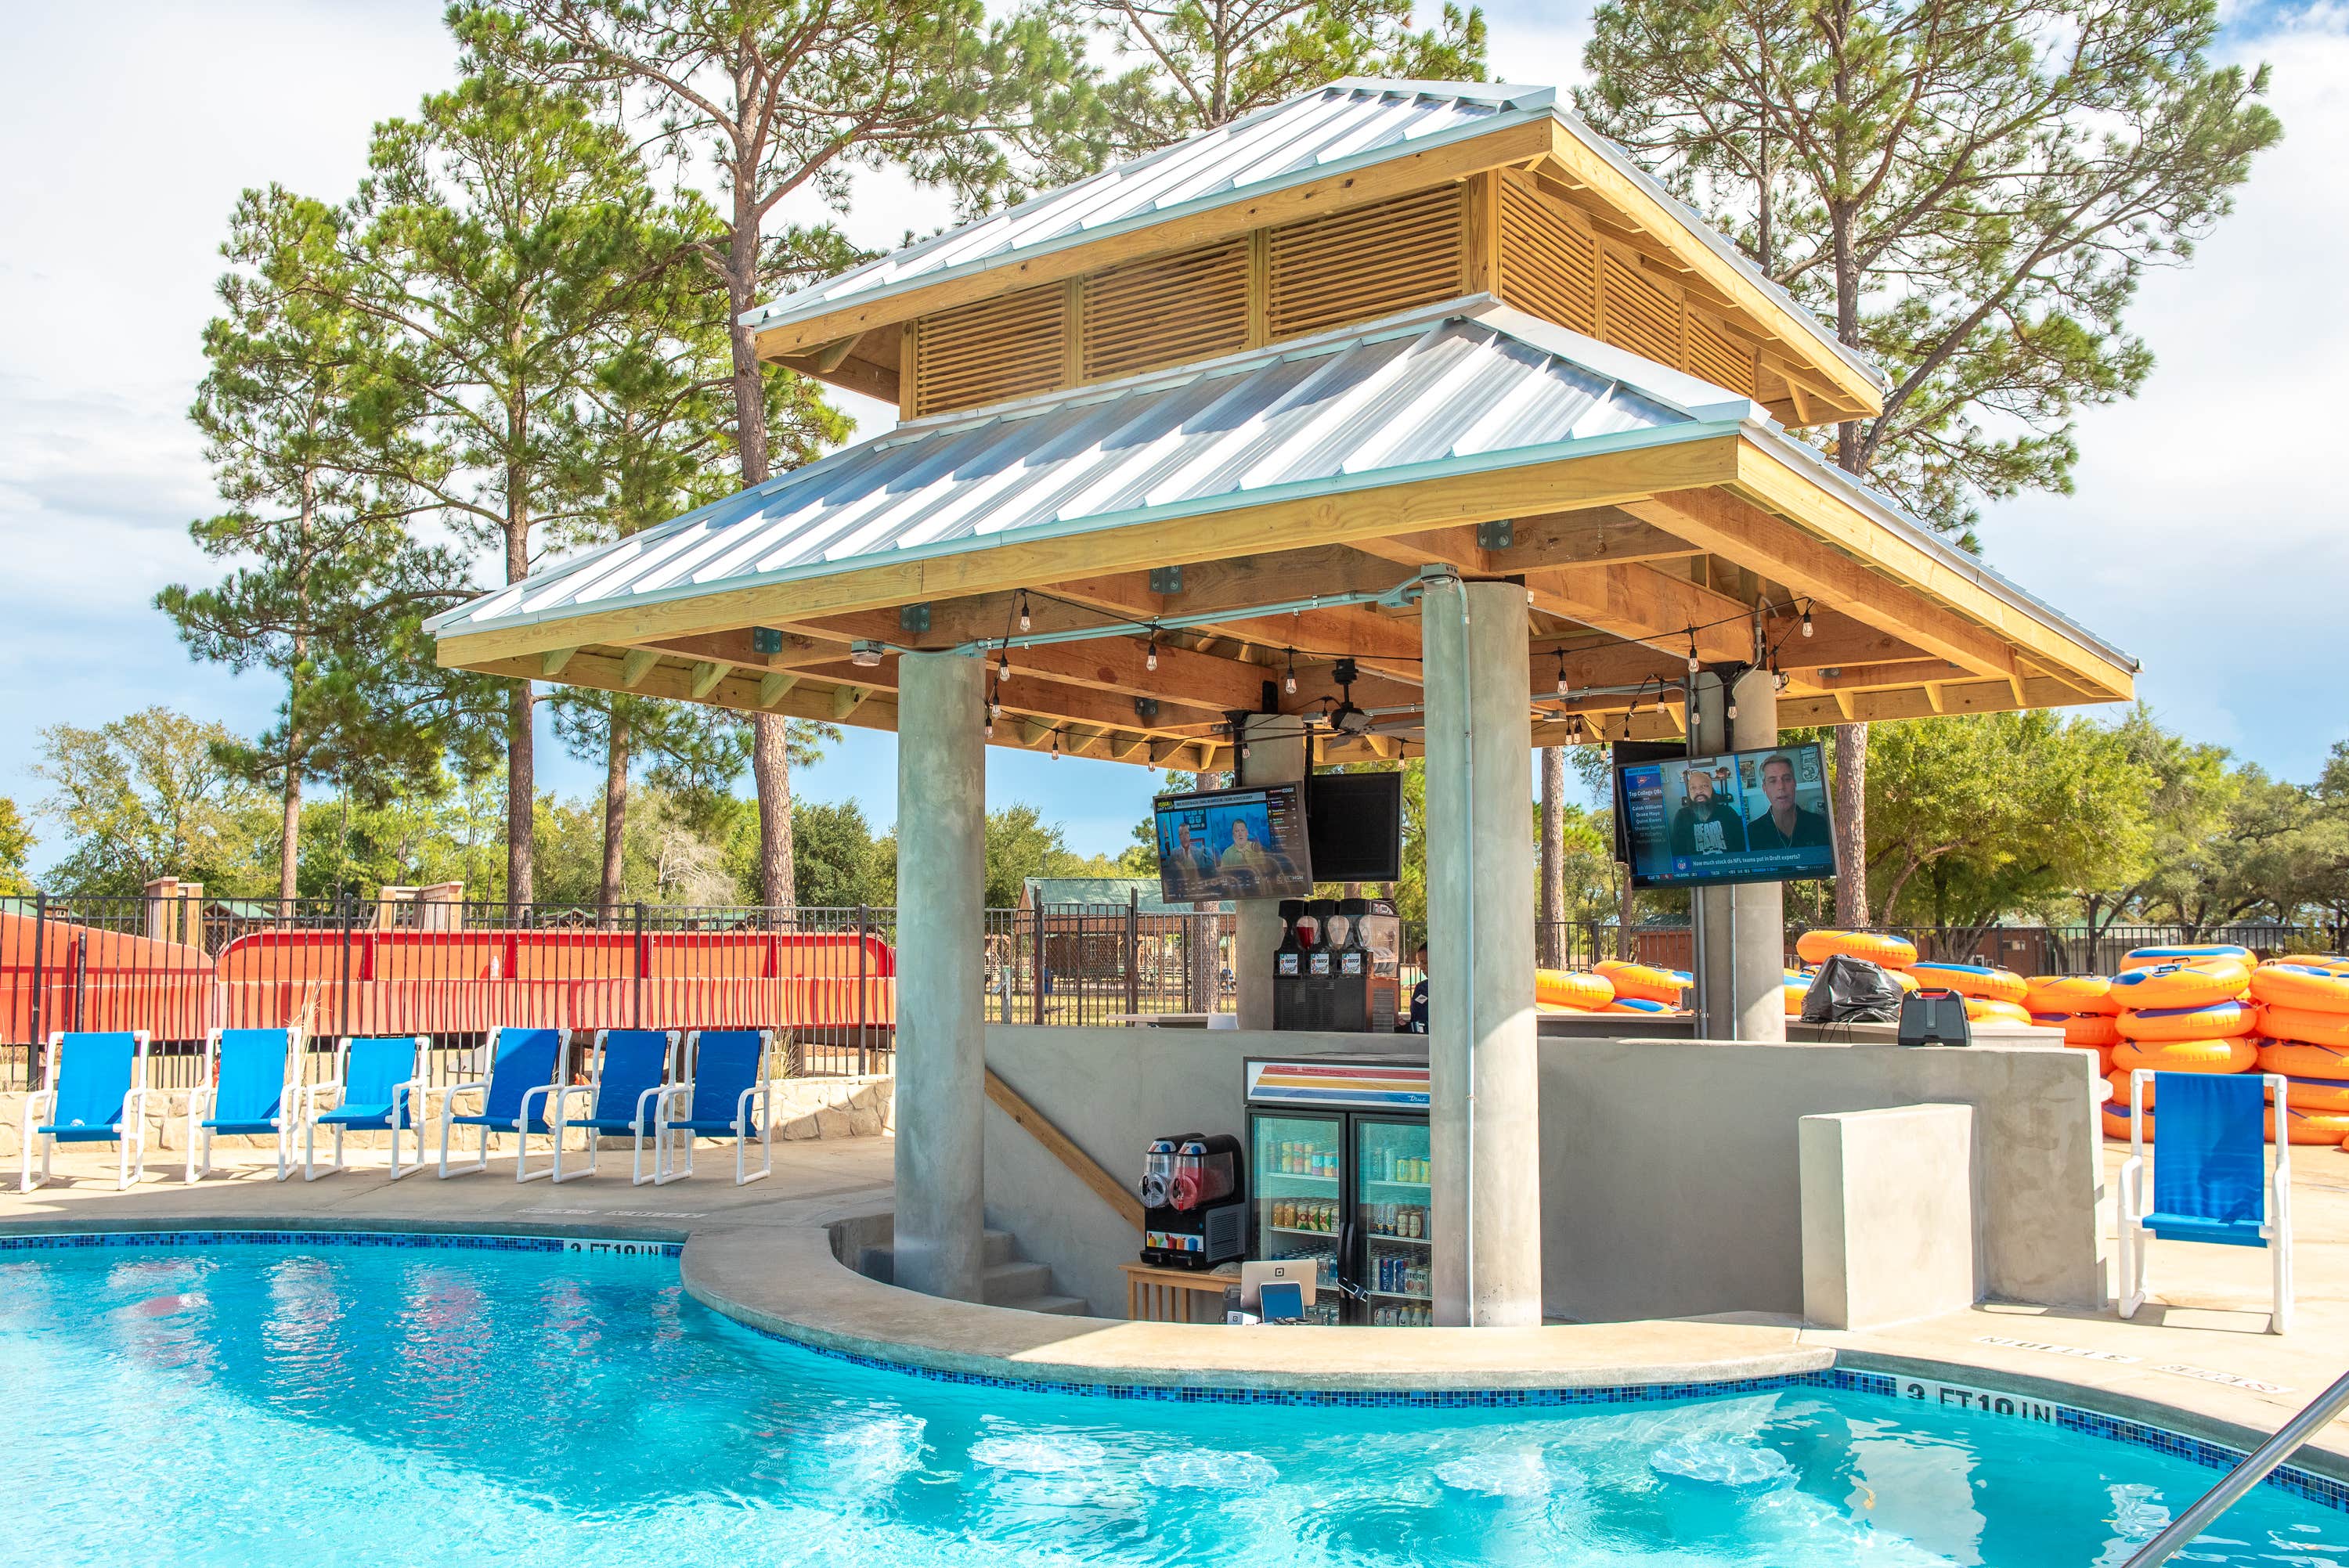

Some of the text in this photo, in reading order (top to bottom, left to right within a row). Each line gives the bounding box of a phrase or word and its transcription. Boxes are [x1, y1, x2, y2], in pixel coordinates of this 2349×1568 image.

[1907, 1383, 2051, 1424] 3 FT 10 IN
